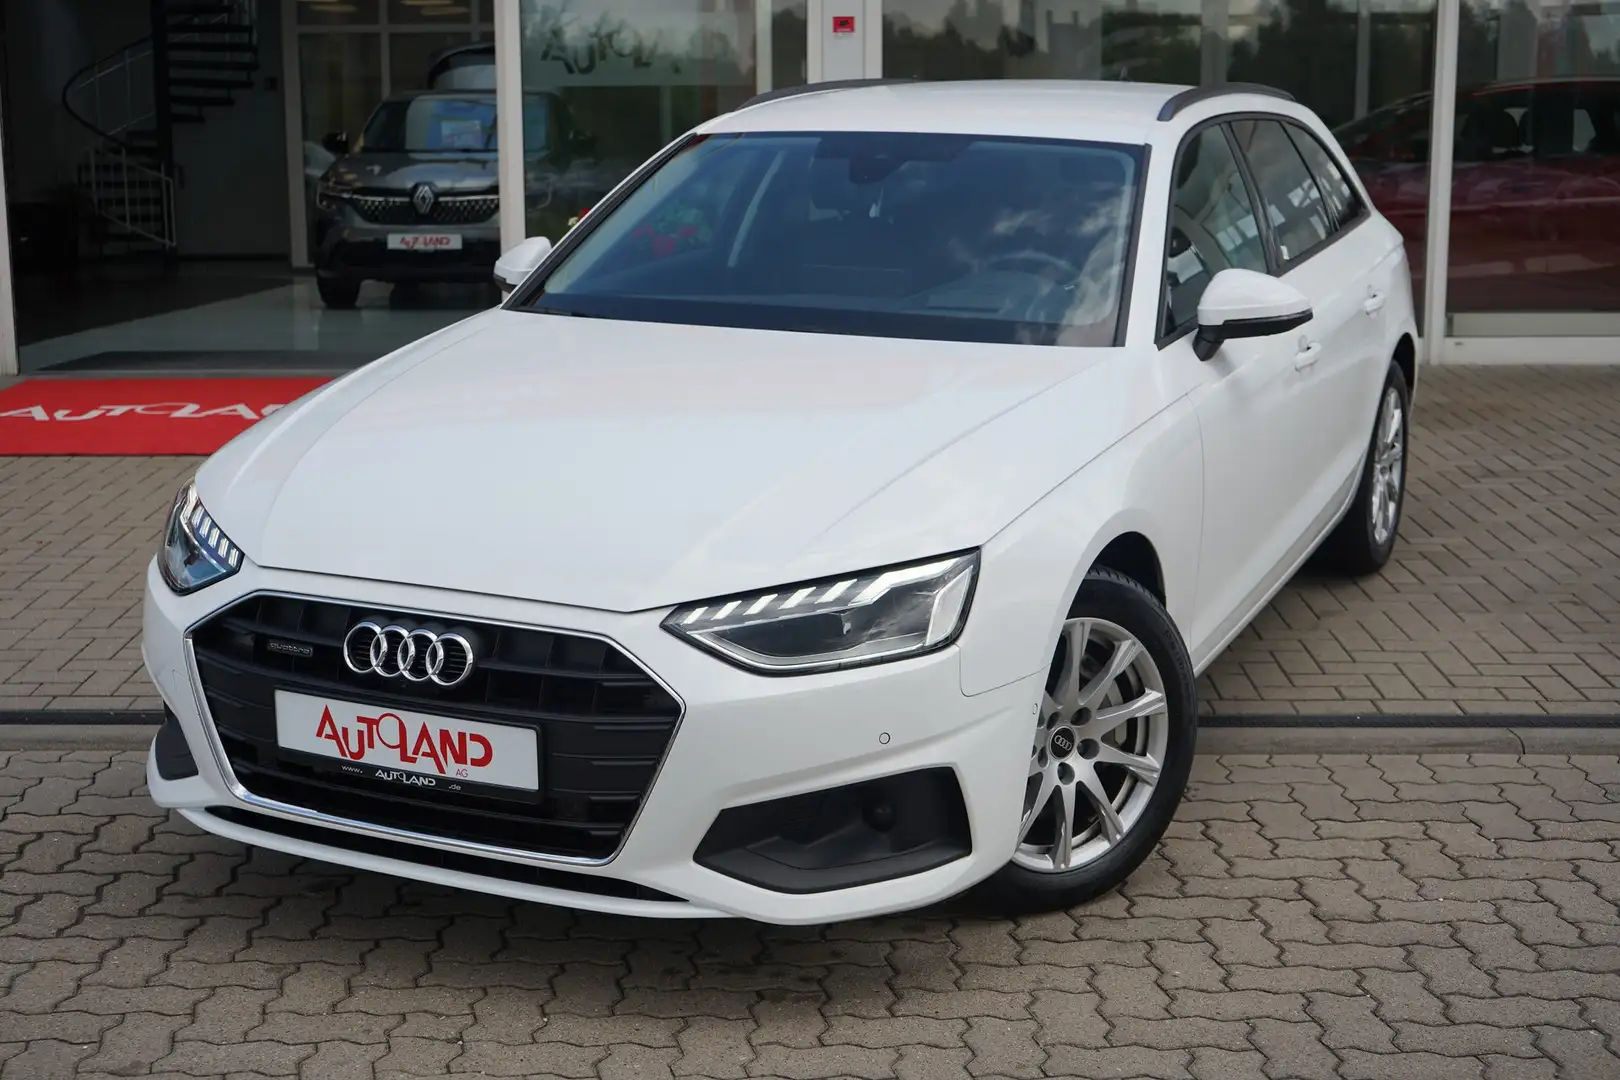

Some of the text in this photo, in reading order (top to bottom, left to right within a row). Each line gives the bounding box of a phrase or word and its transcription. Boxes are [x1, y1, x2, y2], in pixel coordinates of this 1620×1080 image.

[316, 704, 493, 774] AUTOLAND
[375, 769, 436, 786] AUTOLAND
[456, 768, 468, 778] AG
